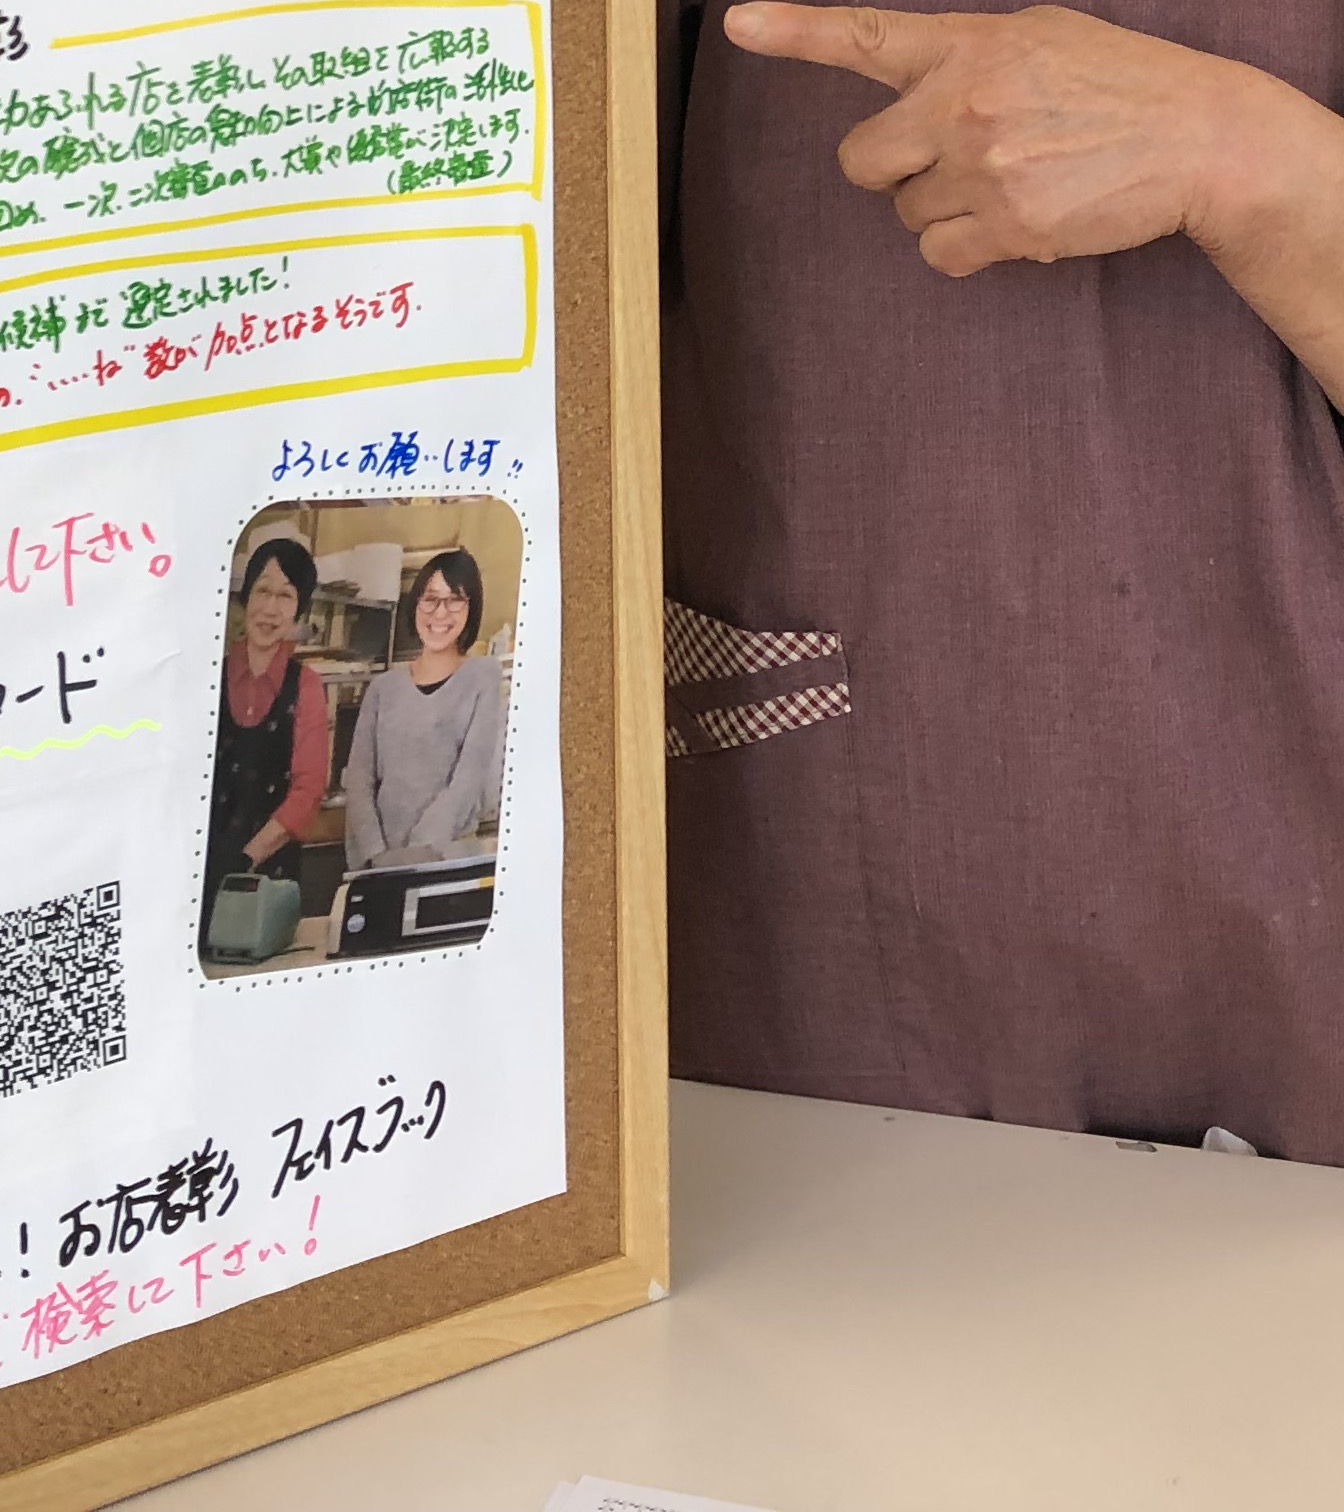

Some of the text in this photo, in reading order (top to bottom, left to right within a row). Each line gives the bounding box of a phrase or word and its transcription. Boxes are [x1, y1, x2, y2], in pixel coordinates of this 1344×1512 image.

[270, 1075, 448, 1199] フェイスブック
